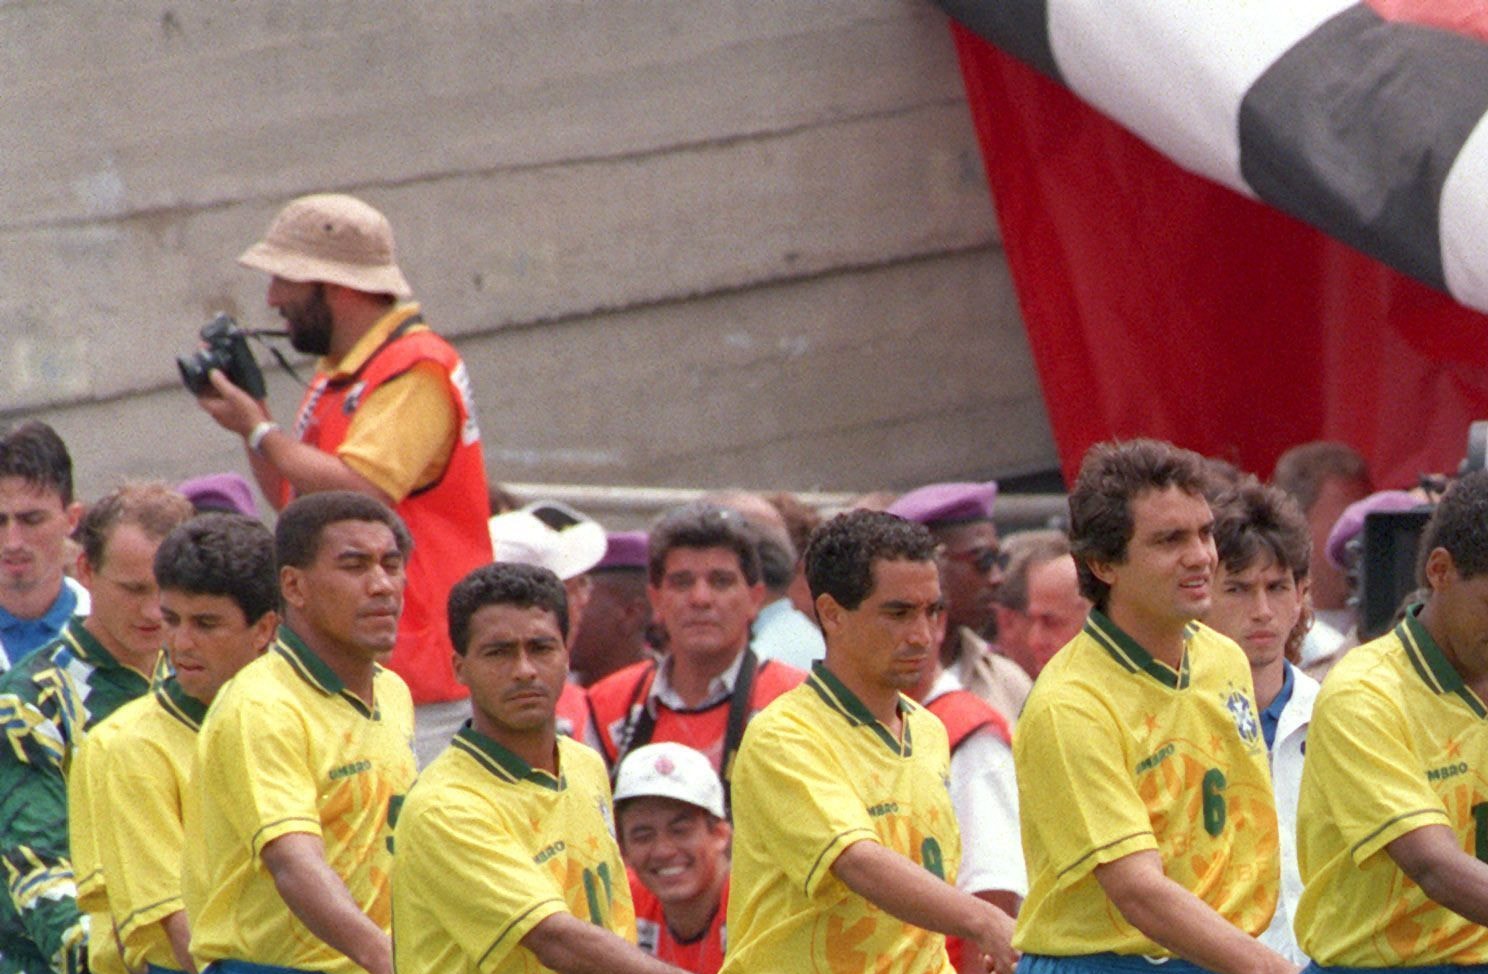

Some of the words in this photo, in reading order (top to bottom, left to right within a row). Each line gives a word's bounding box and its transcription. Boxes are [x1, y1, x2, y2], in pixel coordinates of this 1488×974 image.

[1426, 762, 1468, 781] MBRO
[867, 802, 899, 816] MBRO
[1202, 767, 1226, 837] 6
